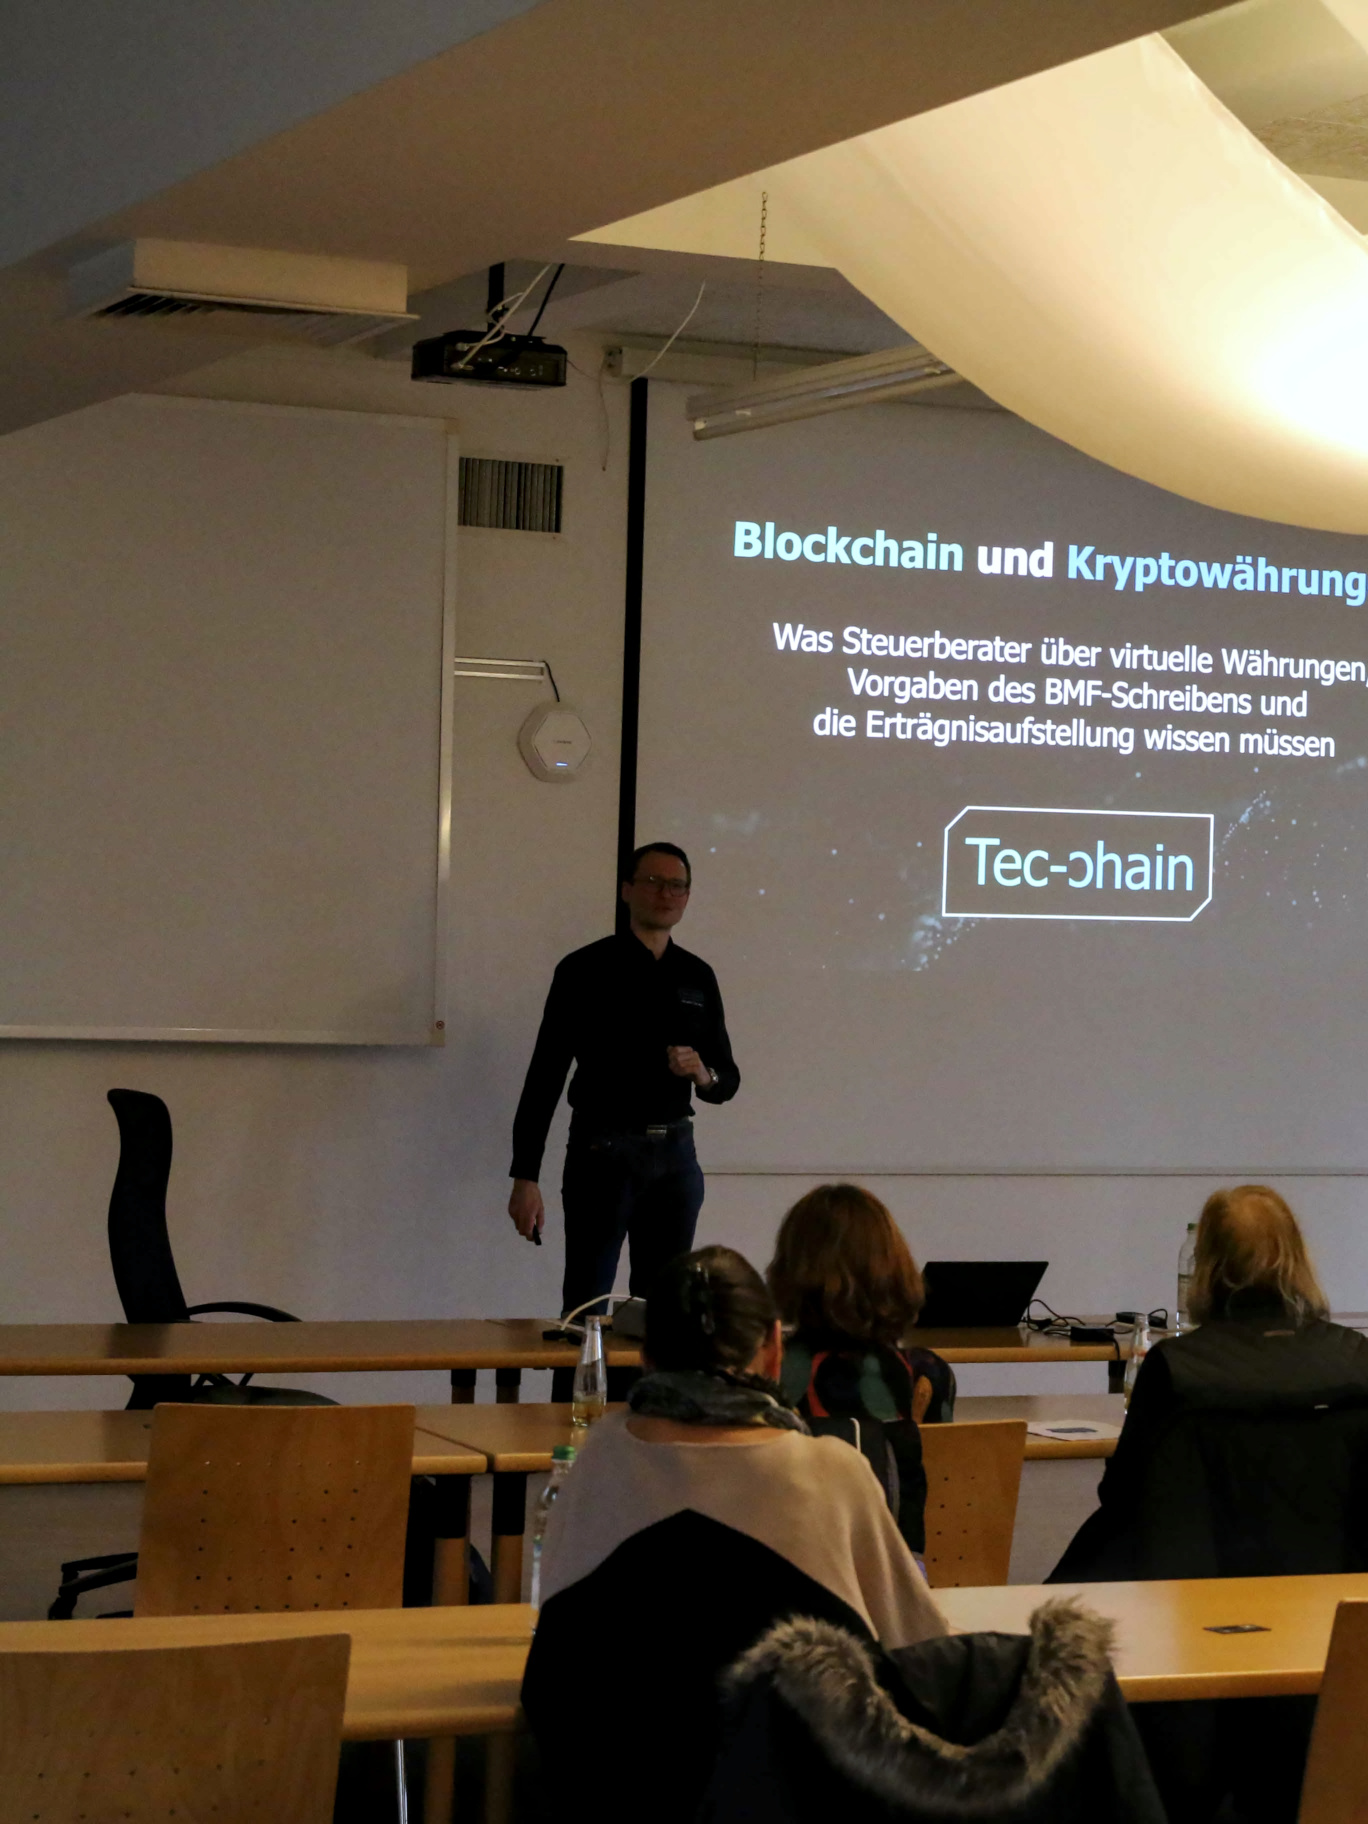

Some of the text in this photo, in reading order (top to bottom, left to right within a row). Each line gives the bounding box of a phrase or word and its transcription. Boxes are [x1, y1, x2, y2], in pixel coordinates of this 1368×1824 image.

[733, 520, 964, 572] Blockchain
[977, 540, 1054, 579] und
[772, 622, 834, 654] Was
[841, 625, 1033, 664] Steuerberater
[1040, 636, 1103, 668] über
[1108, 642, 1214, 674] virtuelle
[846, 667, 1308, 718] Vorgaben des BMF-Schreibens und
[812, 706, 1336, 758] die Erträgnisaufstellung wissen müssen
